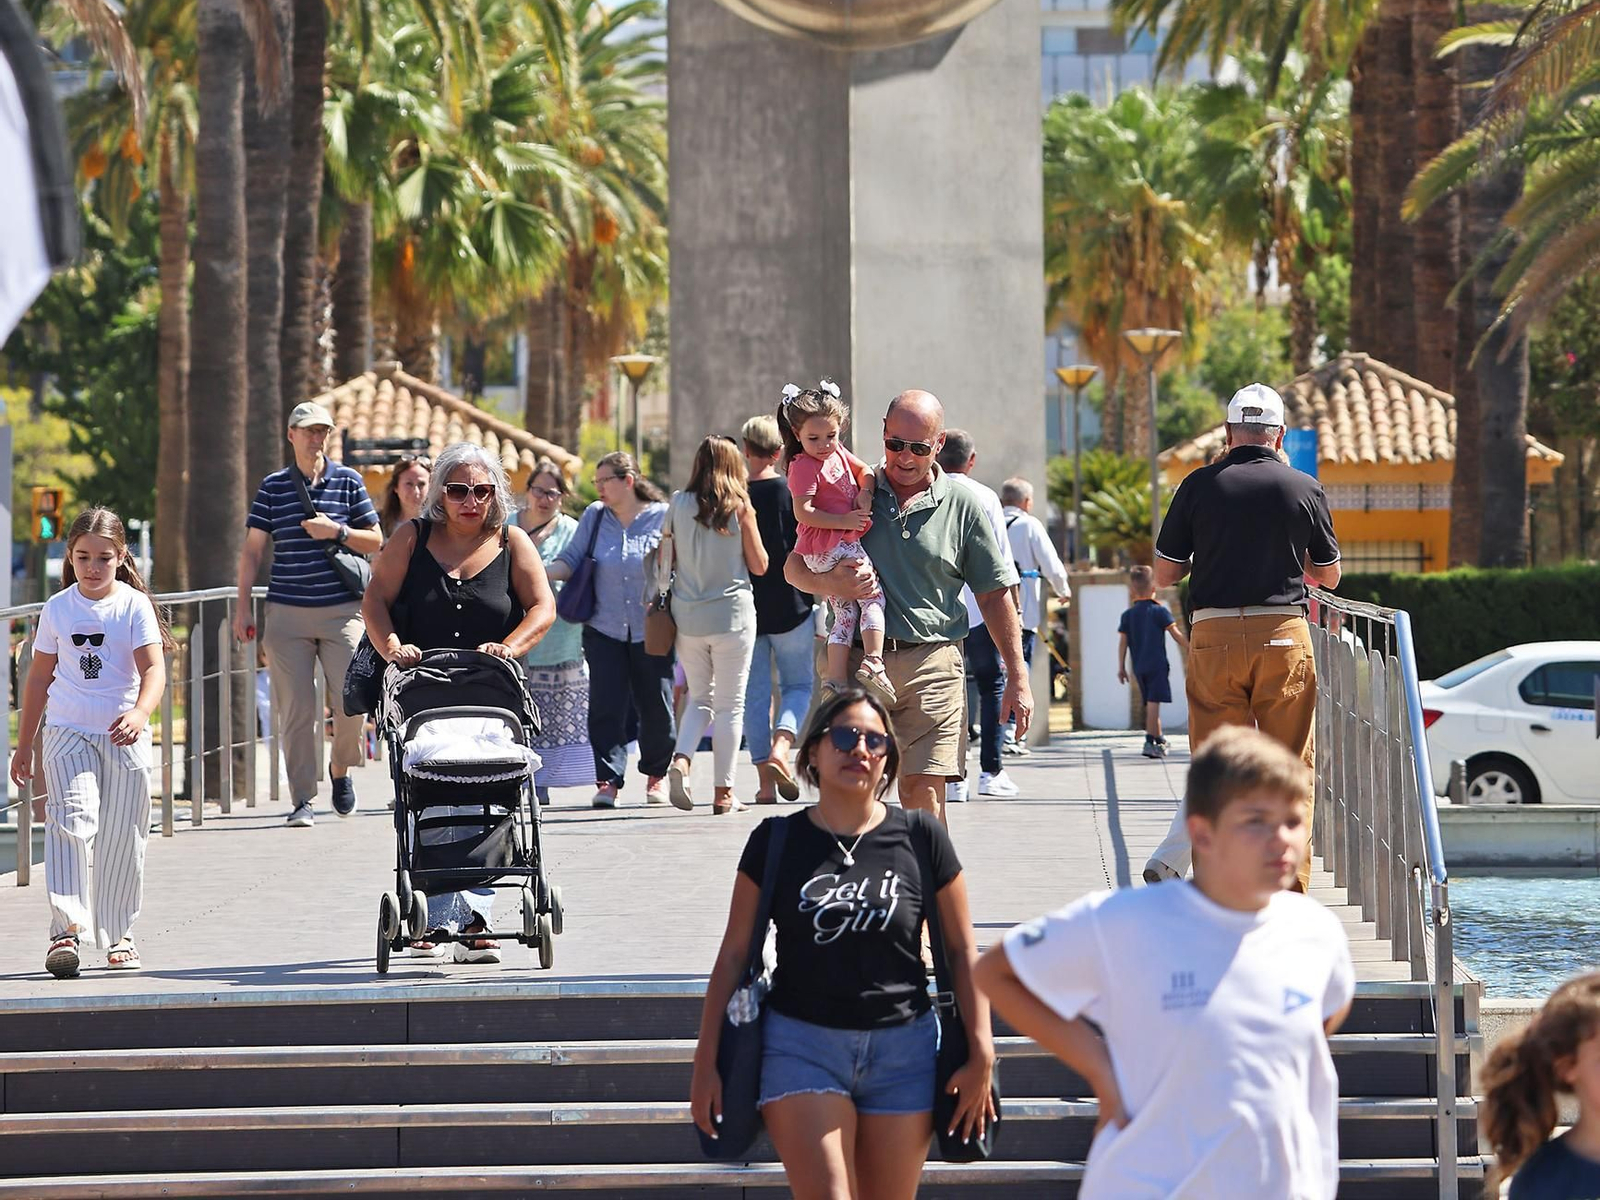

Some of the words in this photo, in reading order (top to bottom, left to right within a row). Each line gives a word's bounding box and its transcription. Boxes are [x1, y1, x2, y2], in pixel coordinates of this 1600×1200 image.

[798, 873, 870, 912] Get
[879, 869, 902, 899] it
[813, 899, 898, 945] Girl
